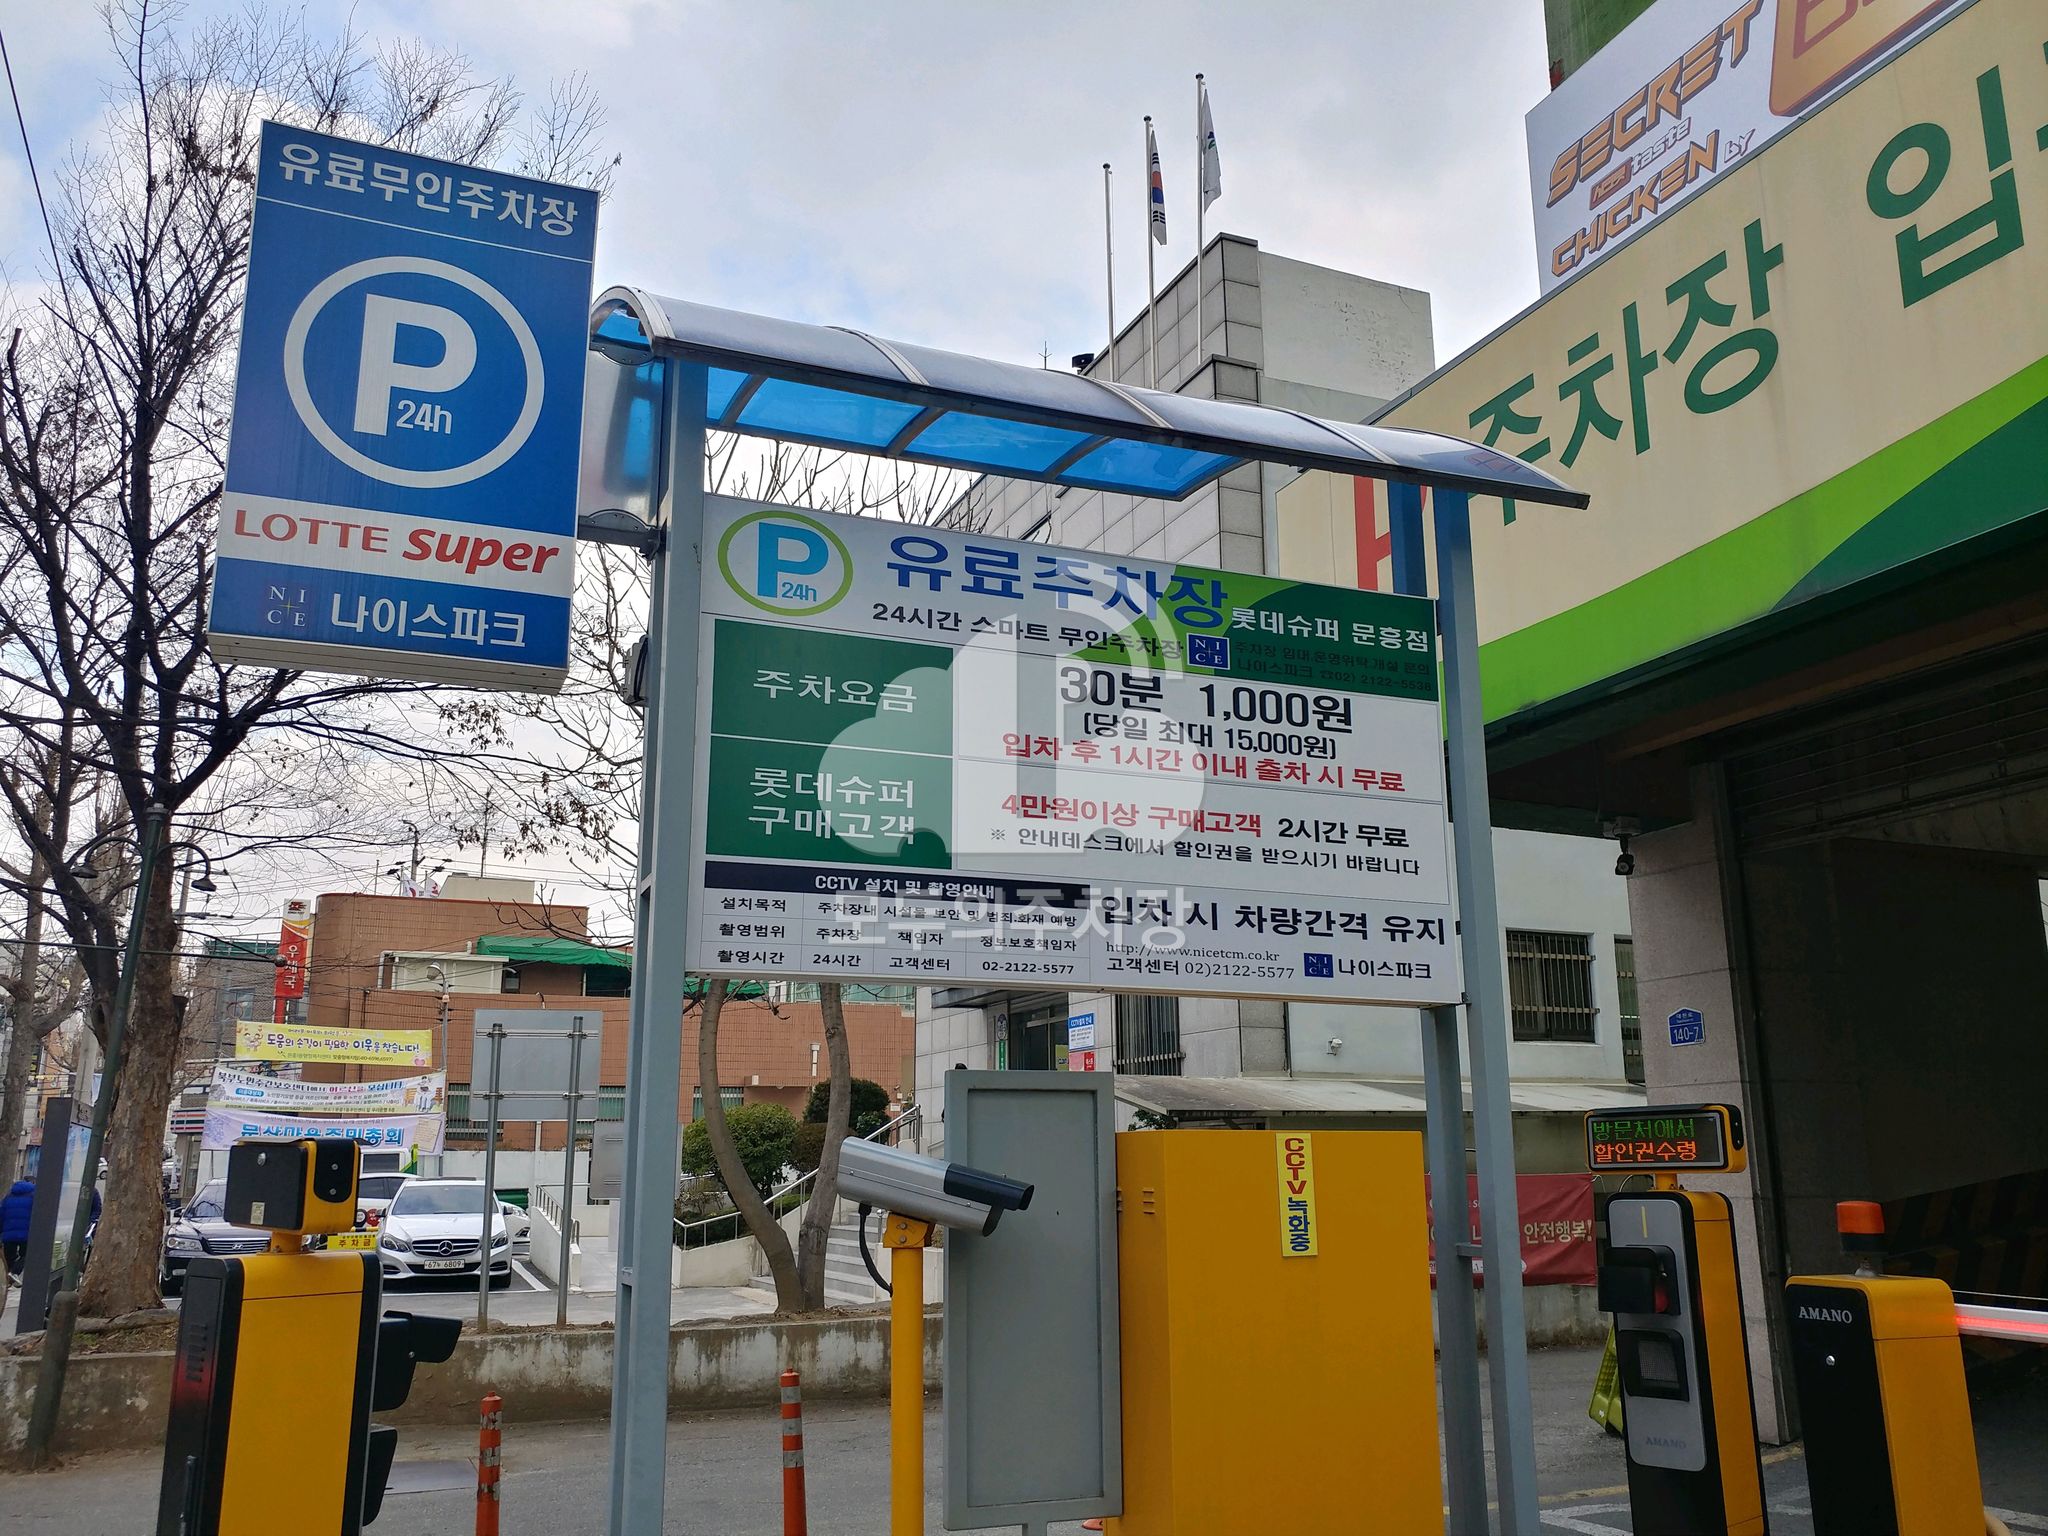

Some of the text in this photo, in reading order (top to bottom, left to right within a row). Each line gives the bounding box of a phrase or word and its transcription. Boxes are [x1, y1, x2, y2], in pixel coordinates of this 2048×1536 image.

[1546, 0, 1764, 208] SECRET
[279, 143, 579, 238] 유료무인주차장
[1551, 129, 1720, 277] CHICKEN
[1466, 40, 2048, 527] 주차장 입
[353, 293, 478, 436] P 24h
[234, 509, 390, 553] LOTTE
[757, 522, 829, 602] P 24h
[887, 535, 1228, 629] 유료주차장
[331, 593, 526, 648] 나이스파크
[872, 603, 1184, 661] 24시간 스마트 무인주차장
[1231, 607, 1430, 653] 롯데슈퍼 문흥점
[753, 669, 918, 713] 주차요금
[1060, 666, 1353, 734] 30분 1,000원
[1158, 720, 1213, 748] 최대
[1002, 733, 1405, 792] 입차 후 1시간 이내 출차 시 무료
[750, 767, 915, 809] 롯데슈퍼
[748, 805, 915, 845] 구매고객
[1001, 794, 1410, 848] 4만원이상 구매고객 2시간 무료
[1018, 827, 1420, 876] 안내데스크에서 할인권을 받으시기 바랍니다
[815, 875, 995, 900] CCTV 설치 및 촬영안내
[720, 896, 787, 912] 설치목적
[817, 901, 877, 917] 주차장내
[884, 905, 926, 920] 시설물
[934, 908, 960, 921] 보안
[967, 910, 981, 923] 및
[1050, 914, 1077, 928] 예방
[1101, 896, 1445, 945] 입차 시 차량간격 유지
[719, 922, 1077, 952] 촬영범위 주차장 책임자 정보보호책임자
[1106, 941, 1280, 962] http://www.nicetcm.co.kr
[717, 949, 1075, 975] 촬영시간 24시간 고객센터 02-2122-5577
[1107, 957, 1295, 980] 고객센터 02)2122-5577
[1338, 959, 1432, 979] 나이스파크
[267, 1033, 294, 1048] 도움의
[352, 1038, 380, 1053] 이웃을
[1673, 1026, 1699, 1043] 140-7
[1592, 1118, 1695, 1141] 방문처에서
[1594, 1140, 1697, 1163] 할인권수령
[1523, 1219, 1592, 1244] 안전행복!
[1798, 1306, 1853, 1324] AMANO
[1645, 1435, 1687, 1449] AMANO
